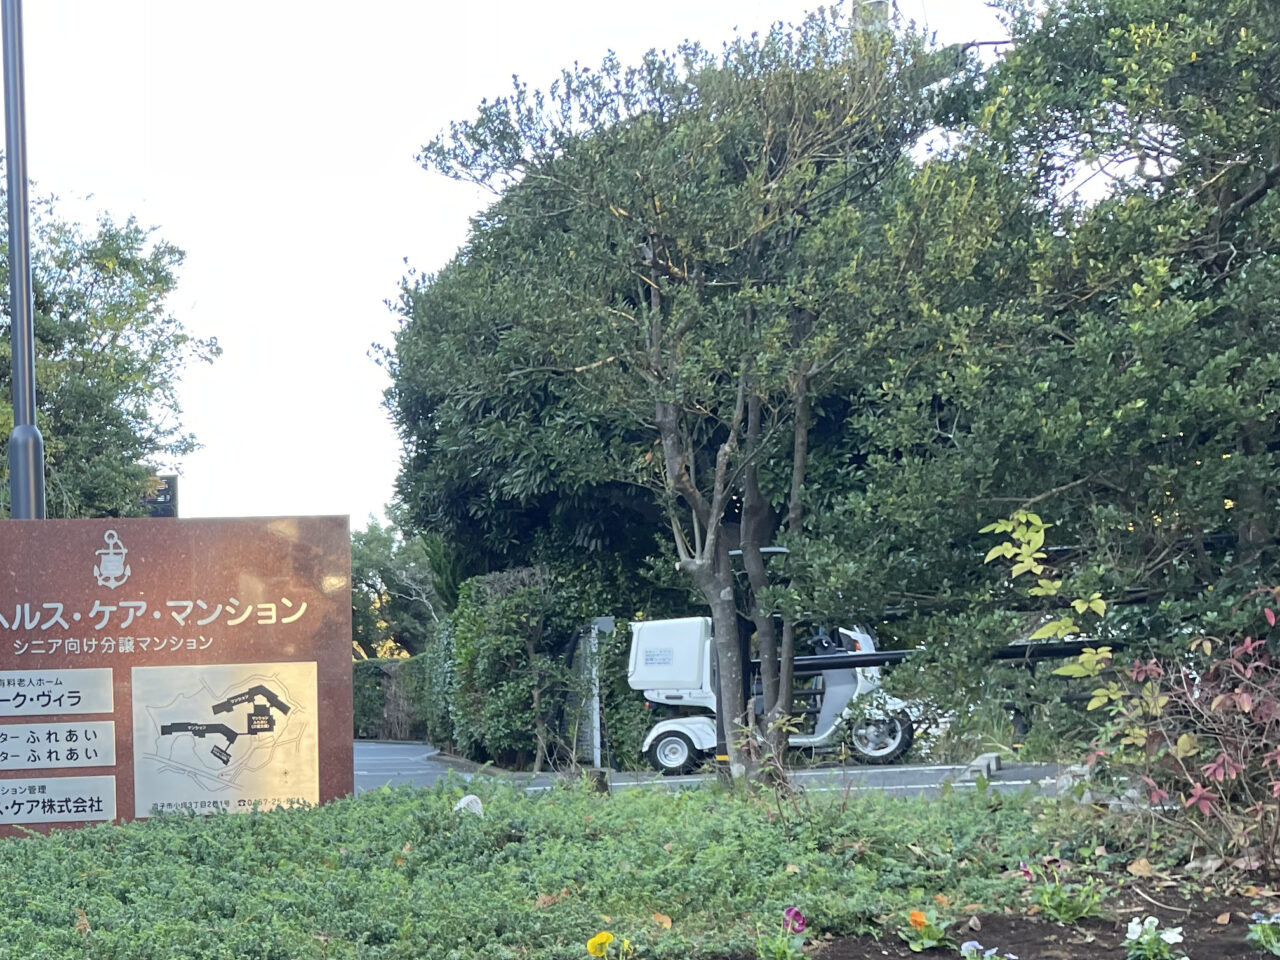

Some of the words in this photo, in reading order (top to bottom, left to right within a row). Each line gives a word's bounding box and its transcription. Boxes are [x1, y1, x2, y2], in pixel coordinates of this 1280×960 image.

[13, 636, 213, 655] シニア向け分譲マンション
[26, 728, 98, 744] ふれあい
[26, 747, 98, 763] ふれあい
